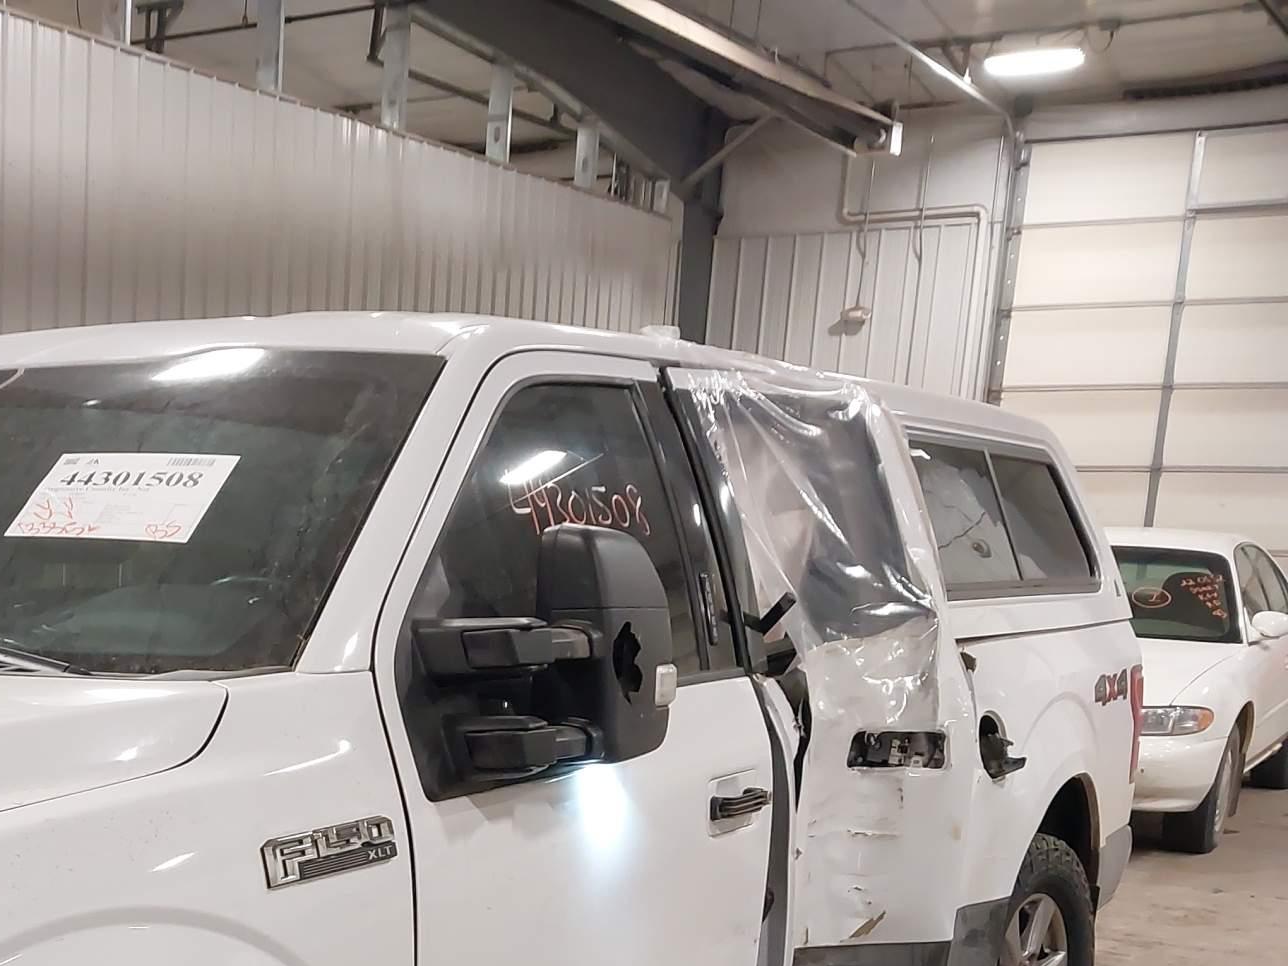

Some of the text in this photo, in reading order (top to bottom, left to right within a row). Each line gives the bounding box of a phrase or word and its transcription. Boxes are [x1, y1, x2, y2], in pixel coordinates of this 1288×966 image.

[60, 470, 204, 489] 44301508
[505, 471, 651, 536] 44301508
[367, 845, 393, 861] XLT
